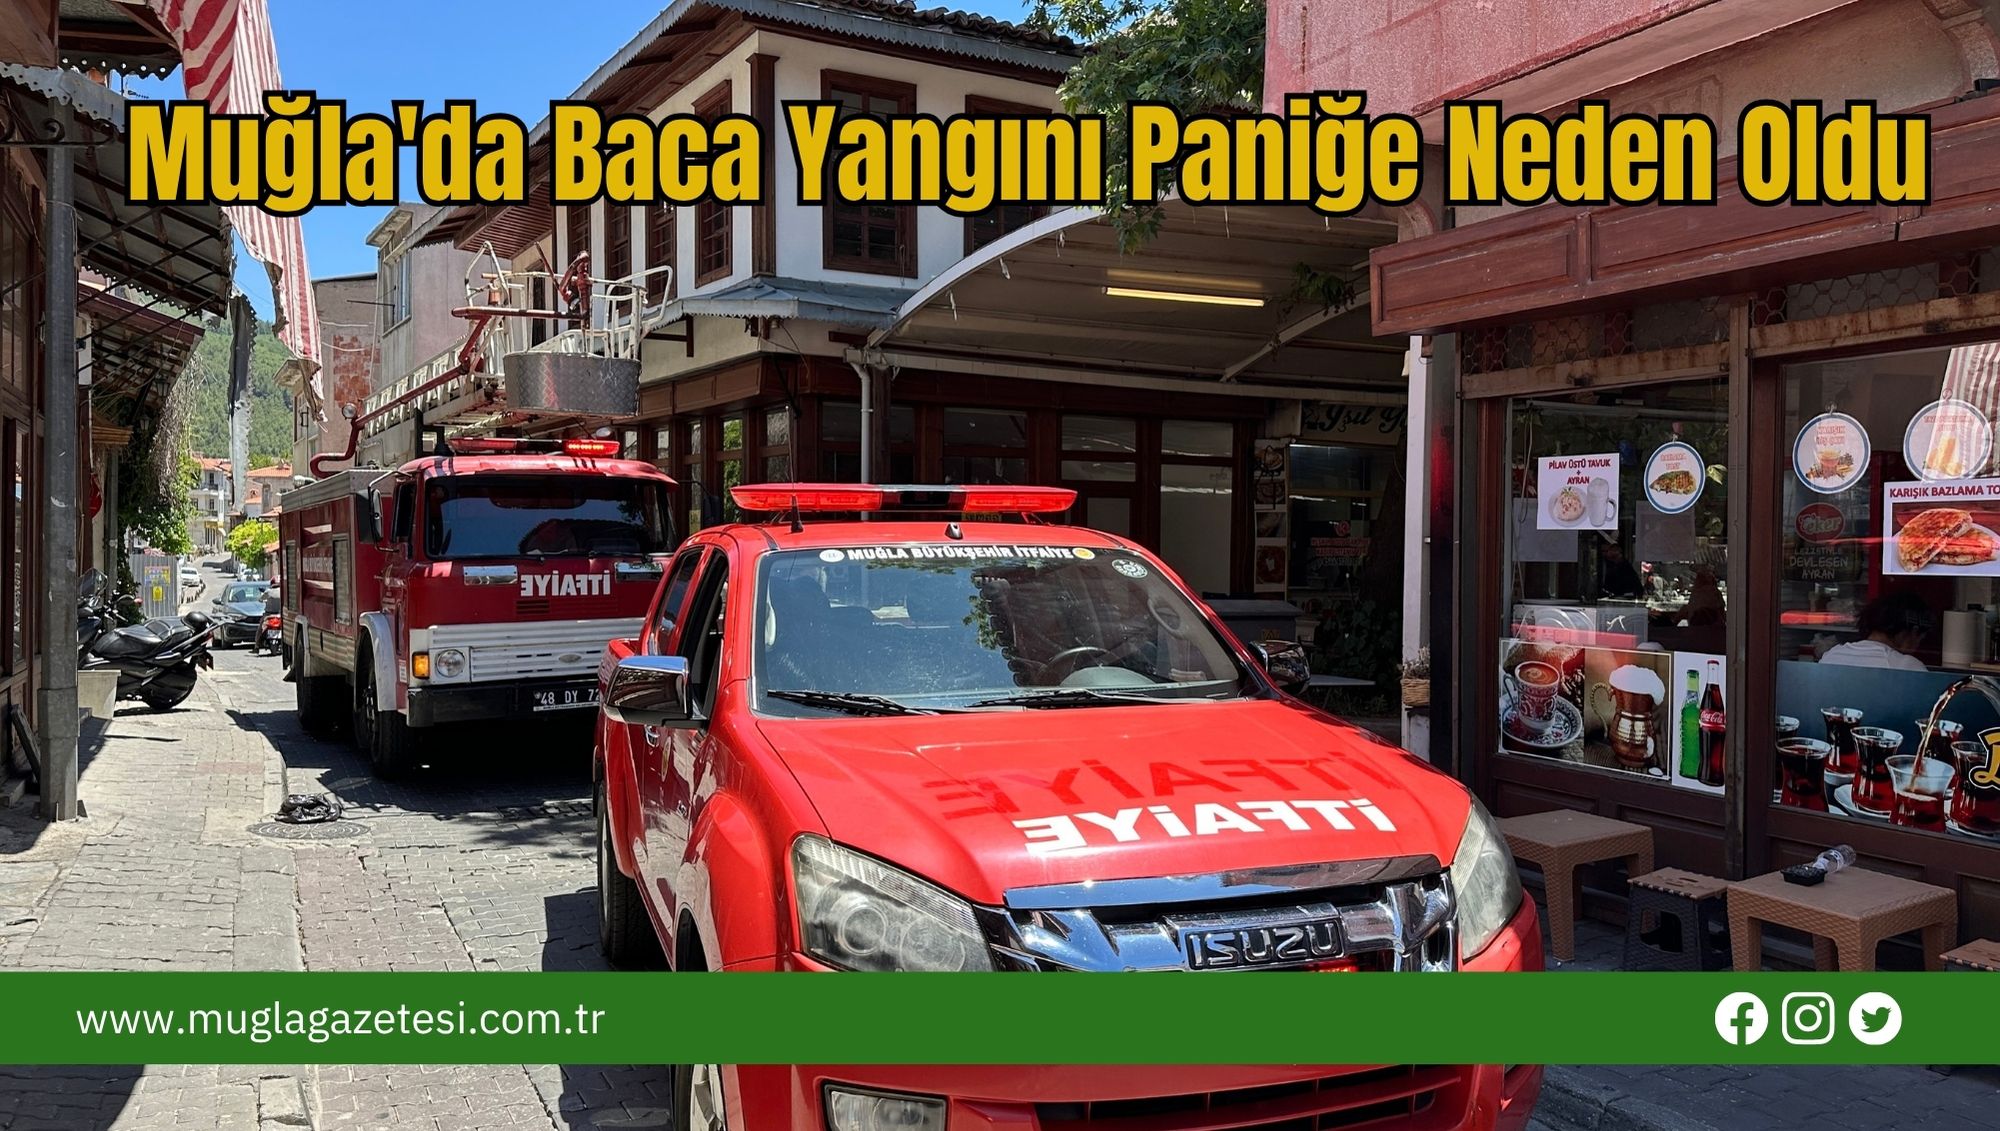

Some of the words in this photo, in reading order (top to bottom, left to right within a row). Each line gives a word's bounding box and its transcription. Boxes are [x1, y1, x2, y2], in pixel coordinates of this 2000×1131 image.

[1549, 460, 1567, 469] PİLAV
[1568, 458, 1587, 469] ÜSTÜ
[1588, 459, 1611, 468] TAVUK
[1567, 476, 1590, 485] AYRAN
[1889, 487, 1929, 499] KARIŞIK
[1931, 486, 1984, 496] BAZLAMA
[848, 547, 907, 560] MUĞLA
[912, 545, 1013, 560] BÜYÜKŞEHİR
[1014, 545, 1074, 559] İTFAİYE
[1802, 569, 1835, 579] AYRAN
[540, 692, 555, 704] 48
[565, 690, 578, 703] DY
[1189, 922, 1336, 967] ISUZU
